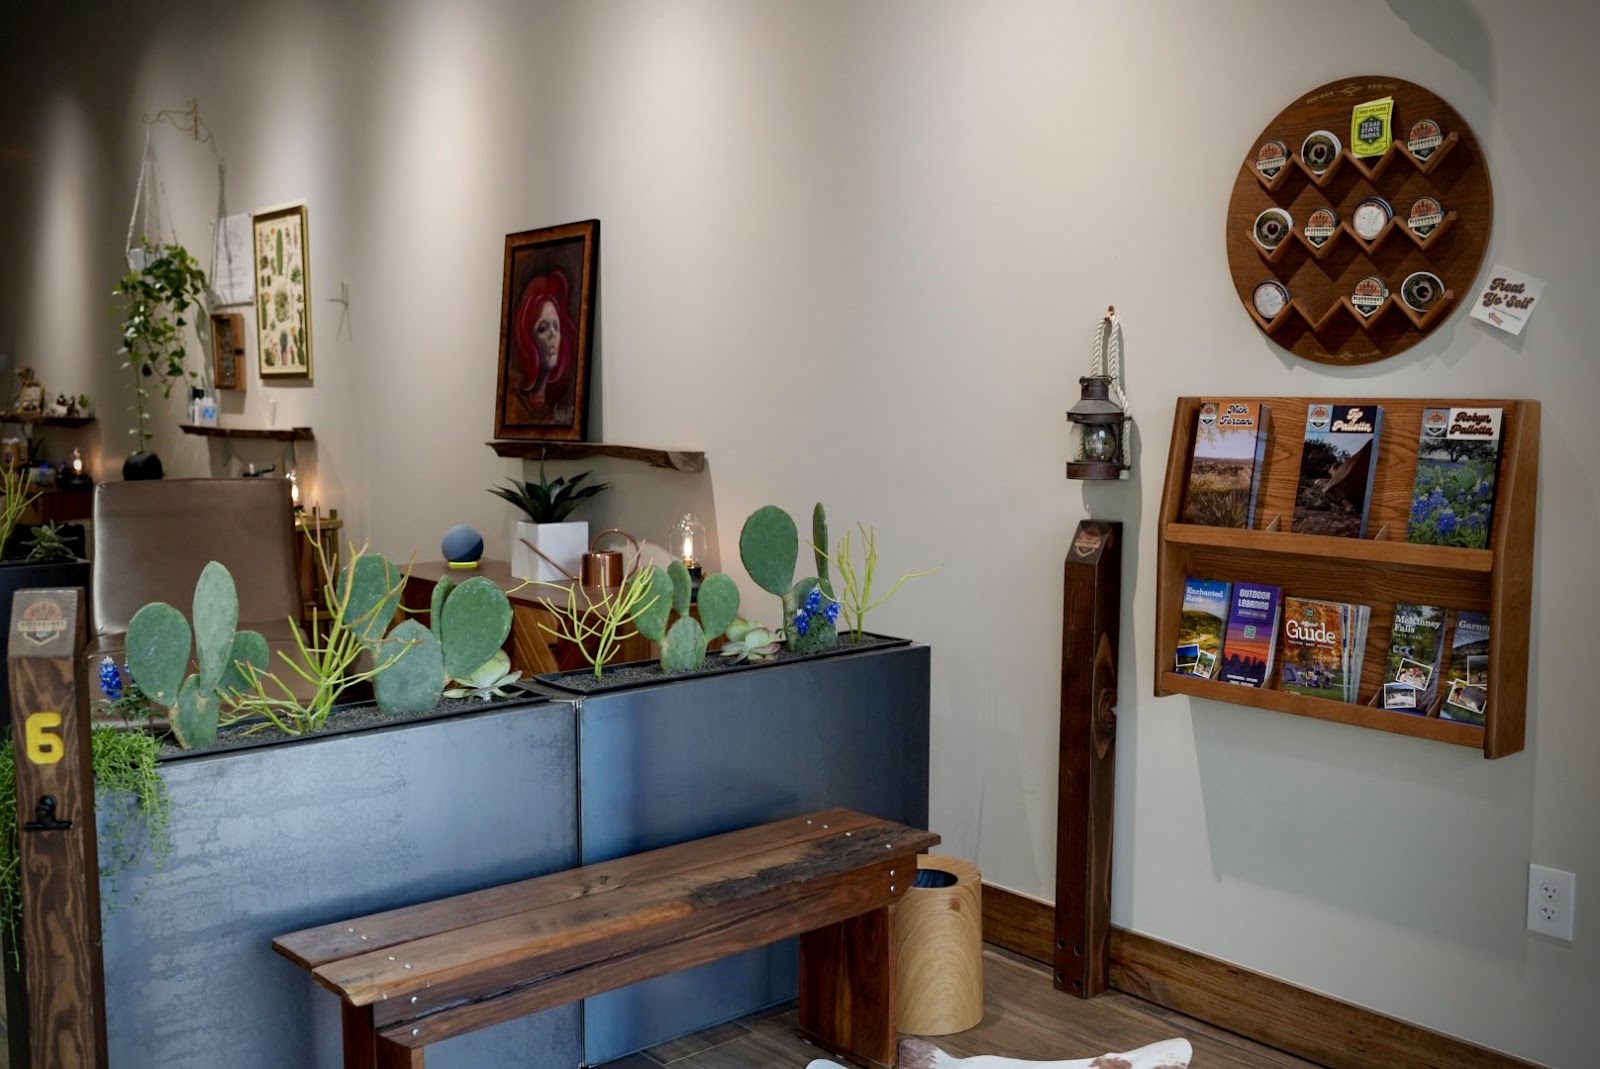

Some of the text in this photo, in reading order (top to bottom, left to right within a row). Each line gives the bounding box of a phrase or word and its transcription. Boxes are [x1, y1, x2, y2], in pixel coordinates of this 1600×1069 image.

[1361, 120, 1381, 128] TEXAS
[1361, 126, 1380, 134] STATE
[1409, 214, 1441, 223] BLUEBONNET
[1489, 277, 1525, 294] Treat
[1226, 404, 1249, 415] Nick
[1219, 415, 1255, 425] Forzani
[1455, 411, 1492, 425] Robyn
[1331, 420, 1373, 433] Pallotta
[1449, 424, 1494, 436] Pallotta
[1186, 586, 1224, 598] Enchanted
[1239, 588, 1271, 600] OUTDOOR
[1395, 615, 1441, 629] McKinney
[1286, 620, 1336, 644] Guide
[1394, 623, 1415, 634] Falls
[25, 712, 64, 765] 6
